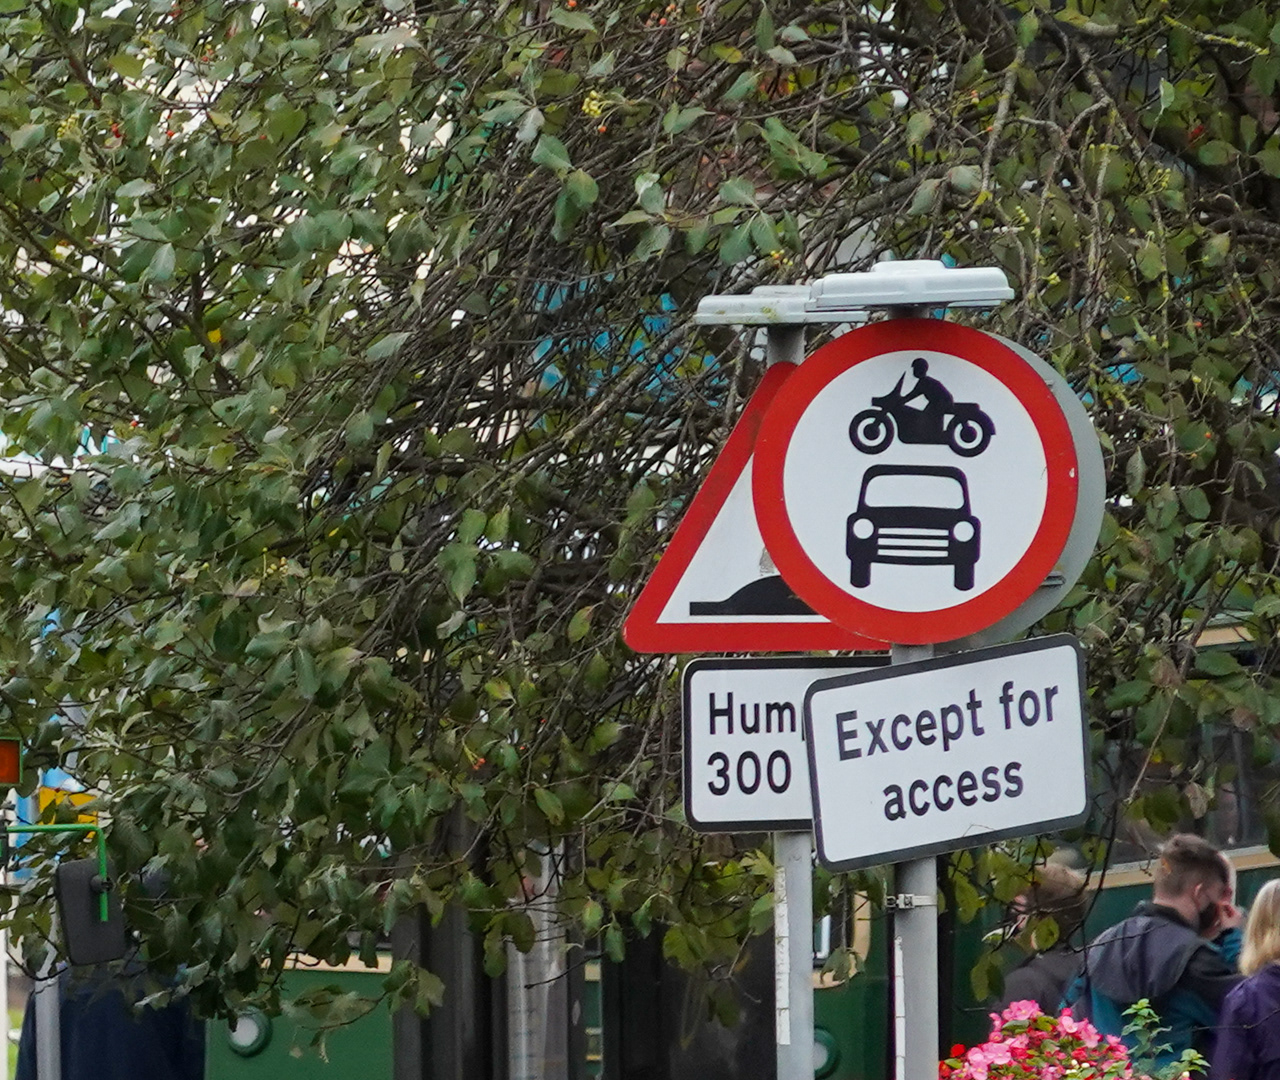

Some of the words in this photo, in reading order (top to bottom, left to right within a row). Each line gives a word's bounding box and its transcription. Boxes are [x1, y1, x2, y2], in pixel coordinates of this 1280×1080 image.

[709, 691, 806, 742] Hum
[836, 687, 984, 762] Except
[1000, 681, 1059, 731] for
[707, 749, 792, 796] 300
[883, 760, 1024, 823] access
